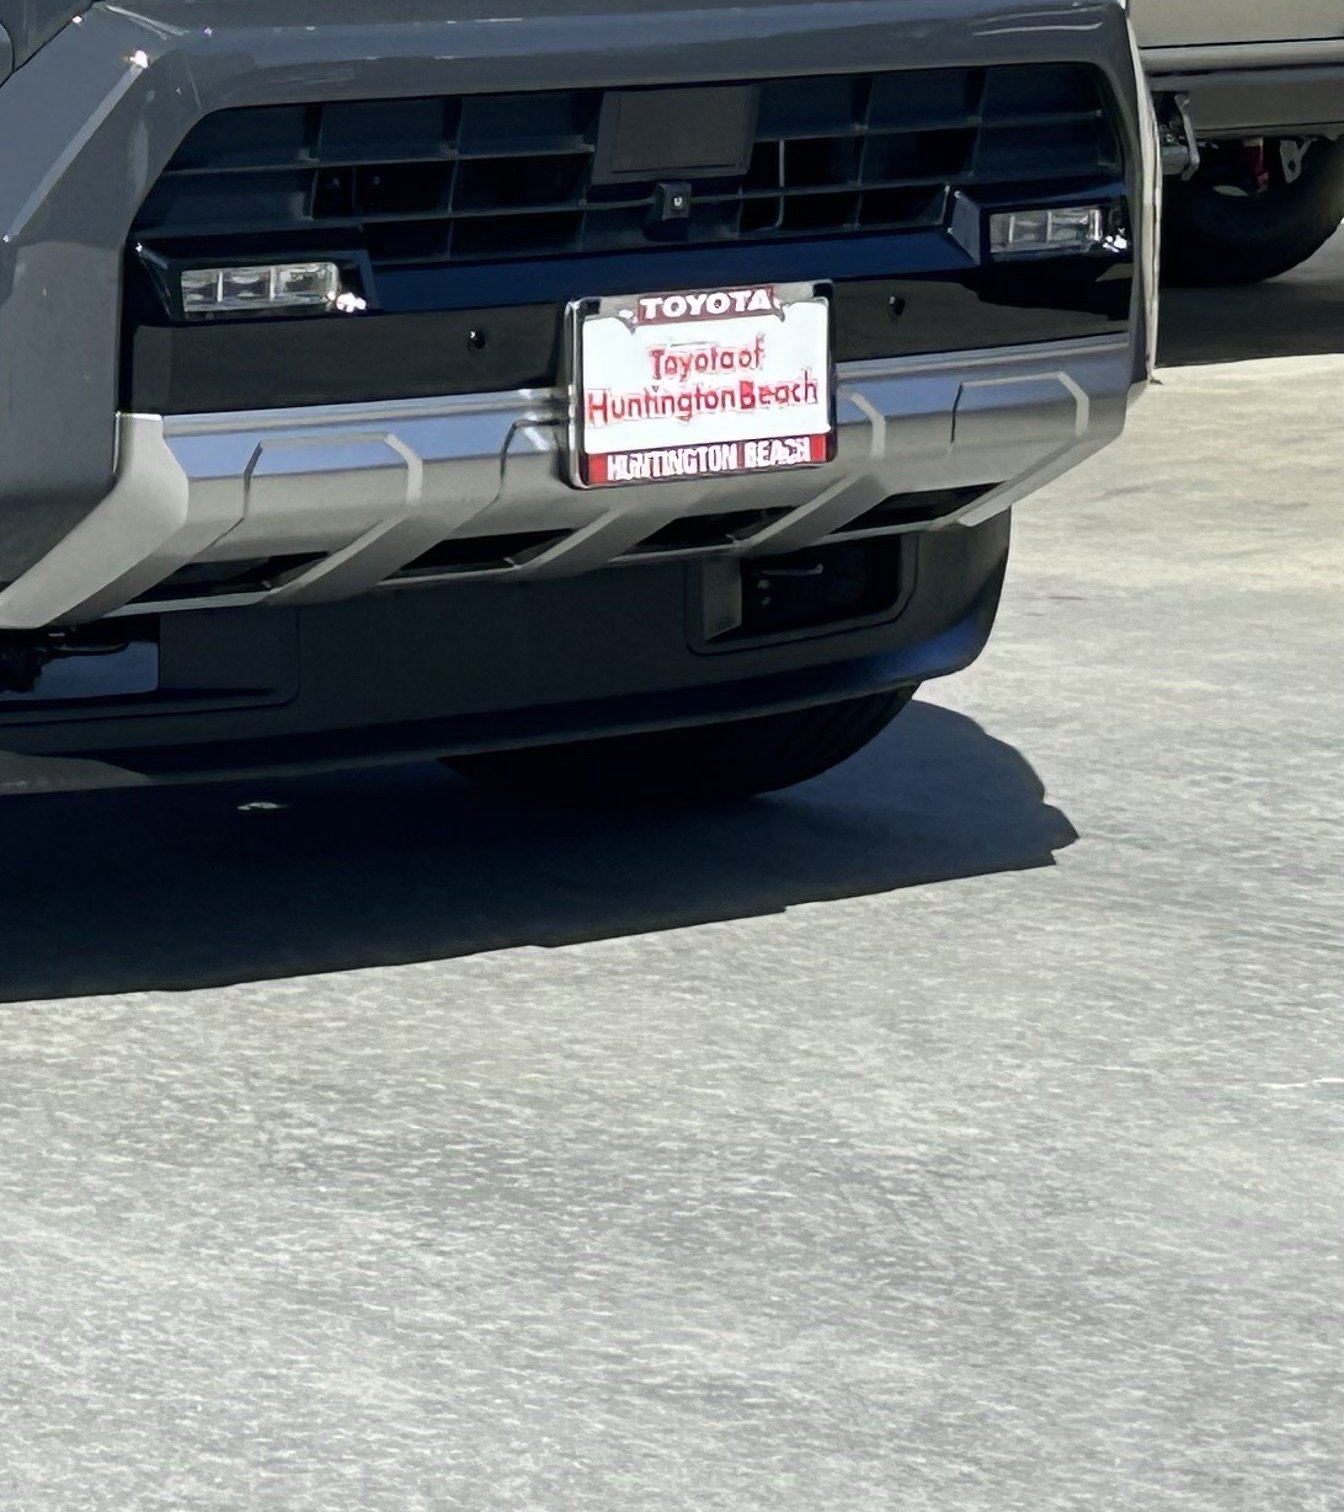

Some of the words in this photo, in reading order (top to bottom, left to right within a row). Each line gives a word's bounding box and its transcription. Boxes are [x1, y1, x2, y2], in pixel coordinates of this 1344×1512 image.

[639, 288, 772, 320] TOYOTA
[649, 346, 734, 382] Toyota
[737, 335, 765, 370] of
[587, 383, 736, 424] Huntington
[738, 370, 819, 410] Beach
[606, 442, 739, 482] HUNTINGTON
[743, 436, 812, 469] BEACH
